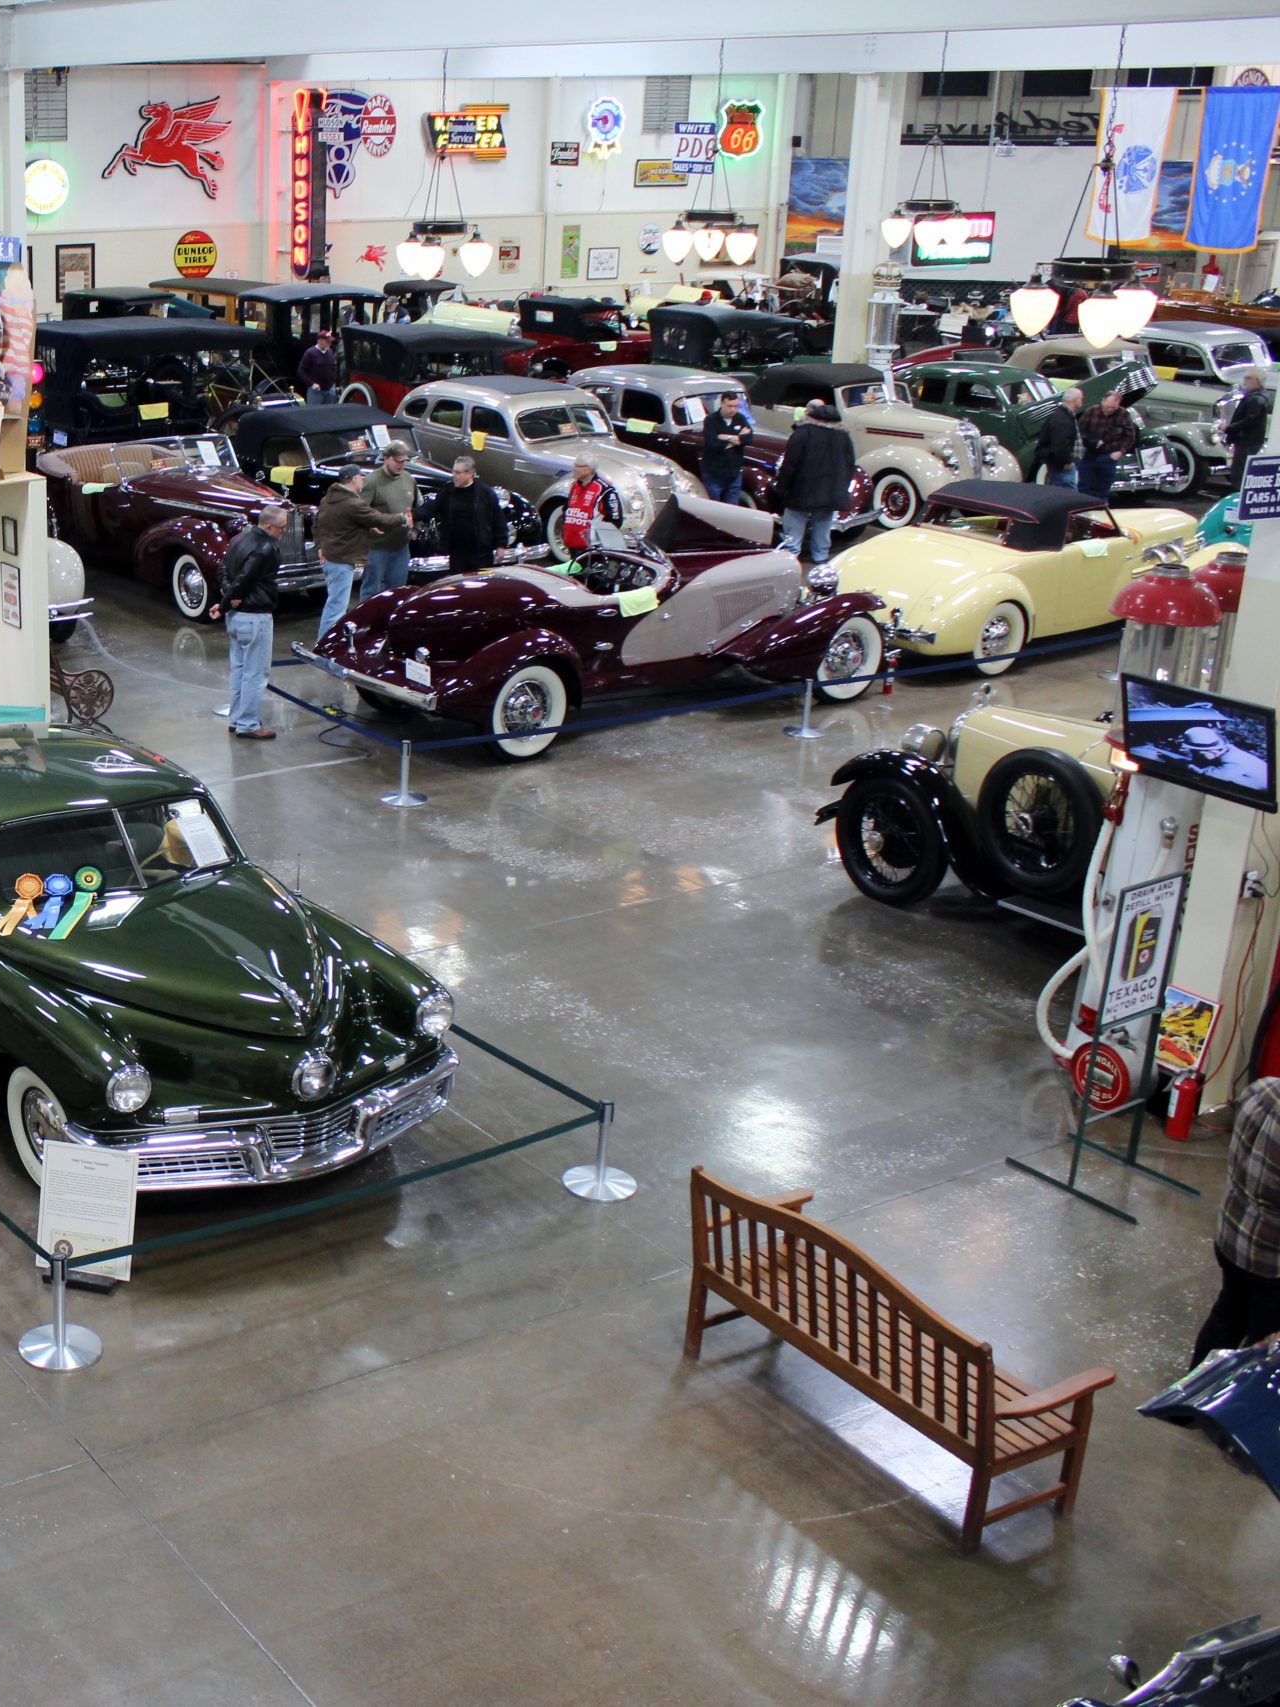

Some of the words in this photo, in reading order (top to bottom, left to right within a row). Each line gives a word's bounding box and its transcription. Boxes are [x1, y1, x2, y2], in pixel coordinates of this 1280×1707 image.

[367, 96, 391, 112] PARTS
[361, 117, 395, 134] Rambler
[679, 124, 711, 133] WHITE
[320, 132, 342, 141] ESSEX
[450, 132, 473, 144] Service
[730, 127, 756, 152] 66
[365, 138, 391, 157] SERVICE
[673, 162, 689, 172] SALES
[293, 135, 310, 266] HUDSON
[177, 246, 214, 256] DUNLOP
[184, 255, 208, 264] TIRES
[1244, 475, 1275, 489] DODGE
[1245, 491, 1271, 505] CARS
[565, 507, 589, 520] Office
[1249, 506, 1269, 515] SALES
[1130, 886, 1156, 901] DRAIN
[1157, 881, 1174, 892] AND
[1125, 899, 1152, 912] REFILL
[1154, 890, 1175, 902] WITH
[1108, 976, 1158, 1000] TEXACO
[1105, 998, 1137, 1014] MOTOR
[1140, 991, 1155, 1004] OIL
